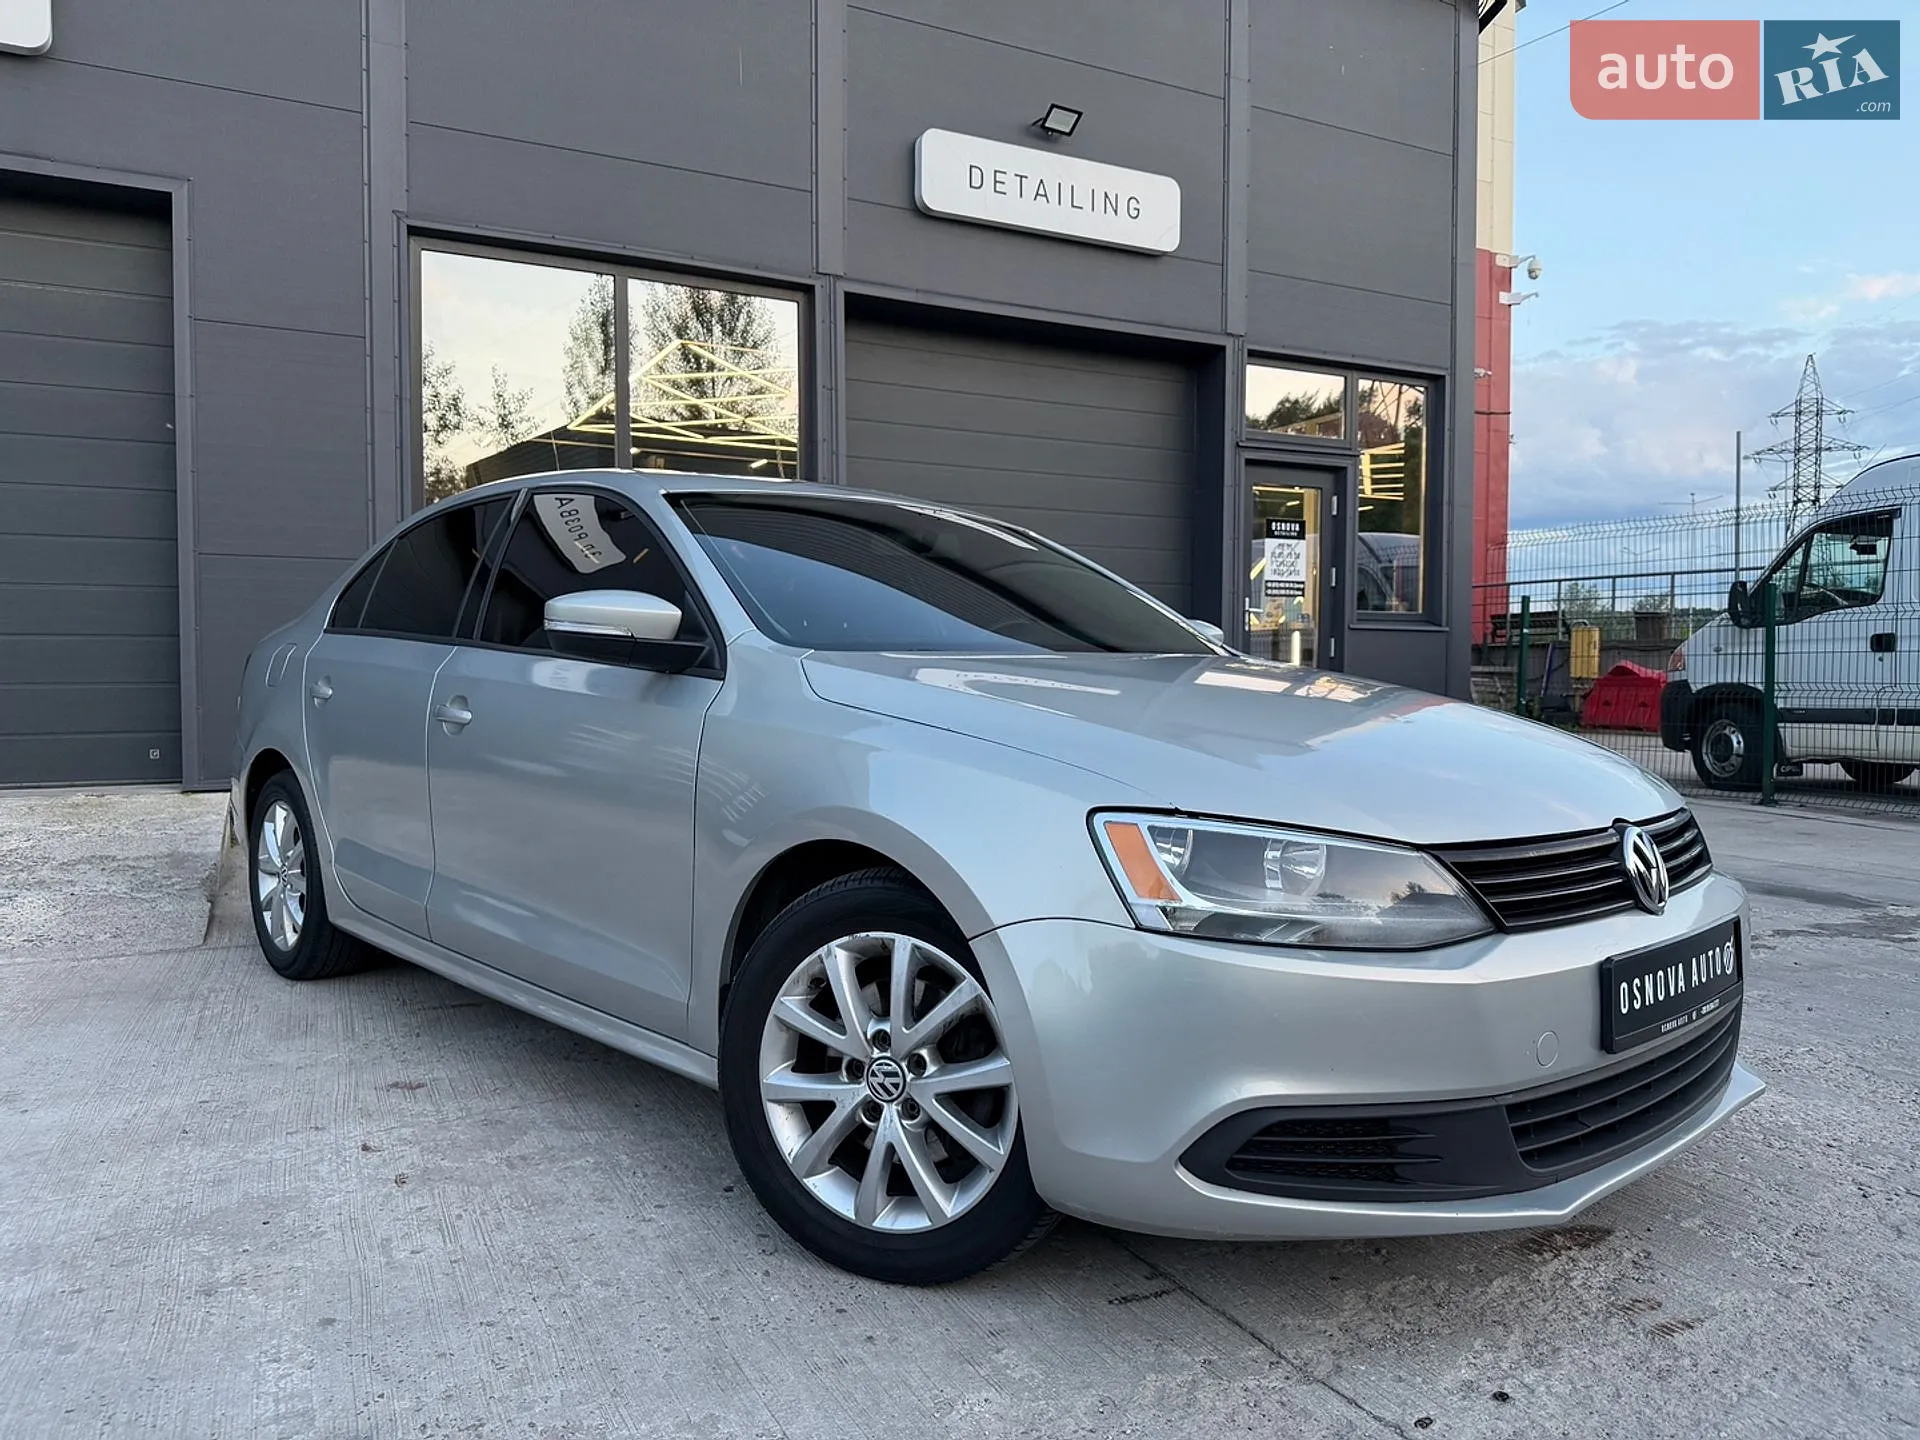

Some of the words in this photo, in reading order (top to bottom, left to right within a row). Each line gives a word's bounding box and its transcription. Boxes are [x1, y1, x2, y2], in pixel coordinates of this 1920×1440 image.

[968, 164, 1142, 220] DETAILING
[1271, 521, 1300, 532] OSNOVA
[1619, 962, 1686, 1014] OSNOVA
[1691, 946, 1722, 988] AUTO
